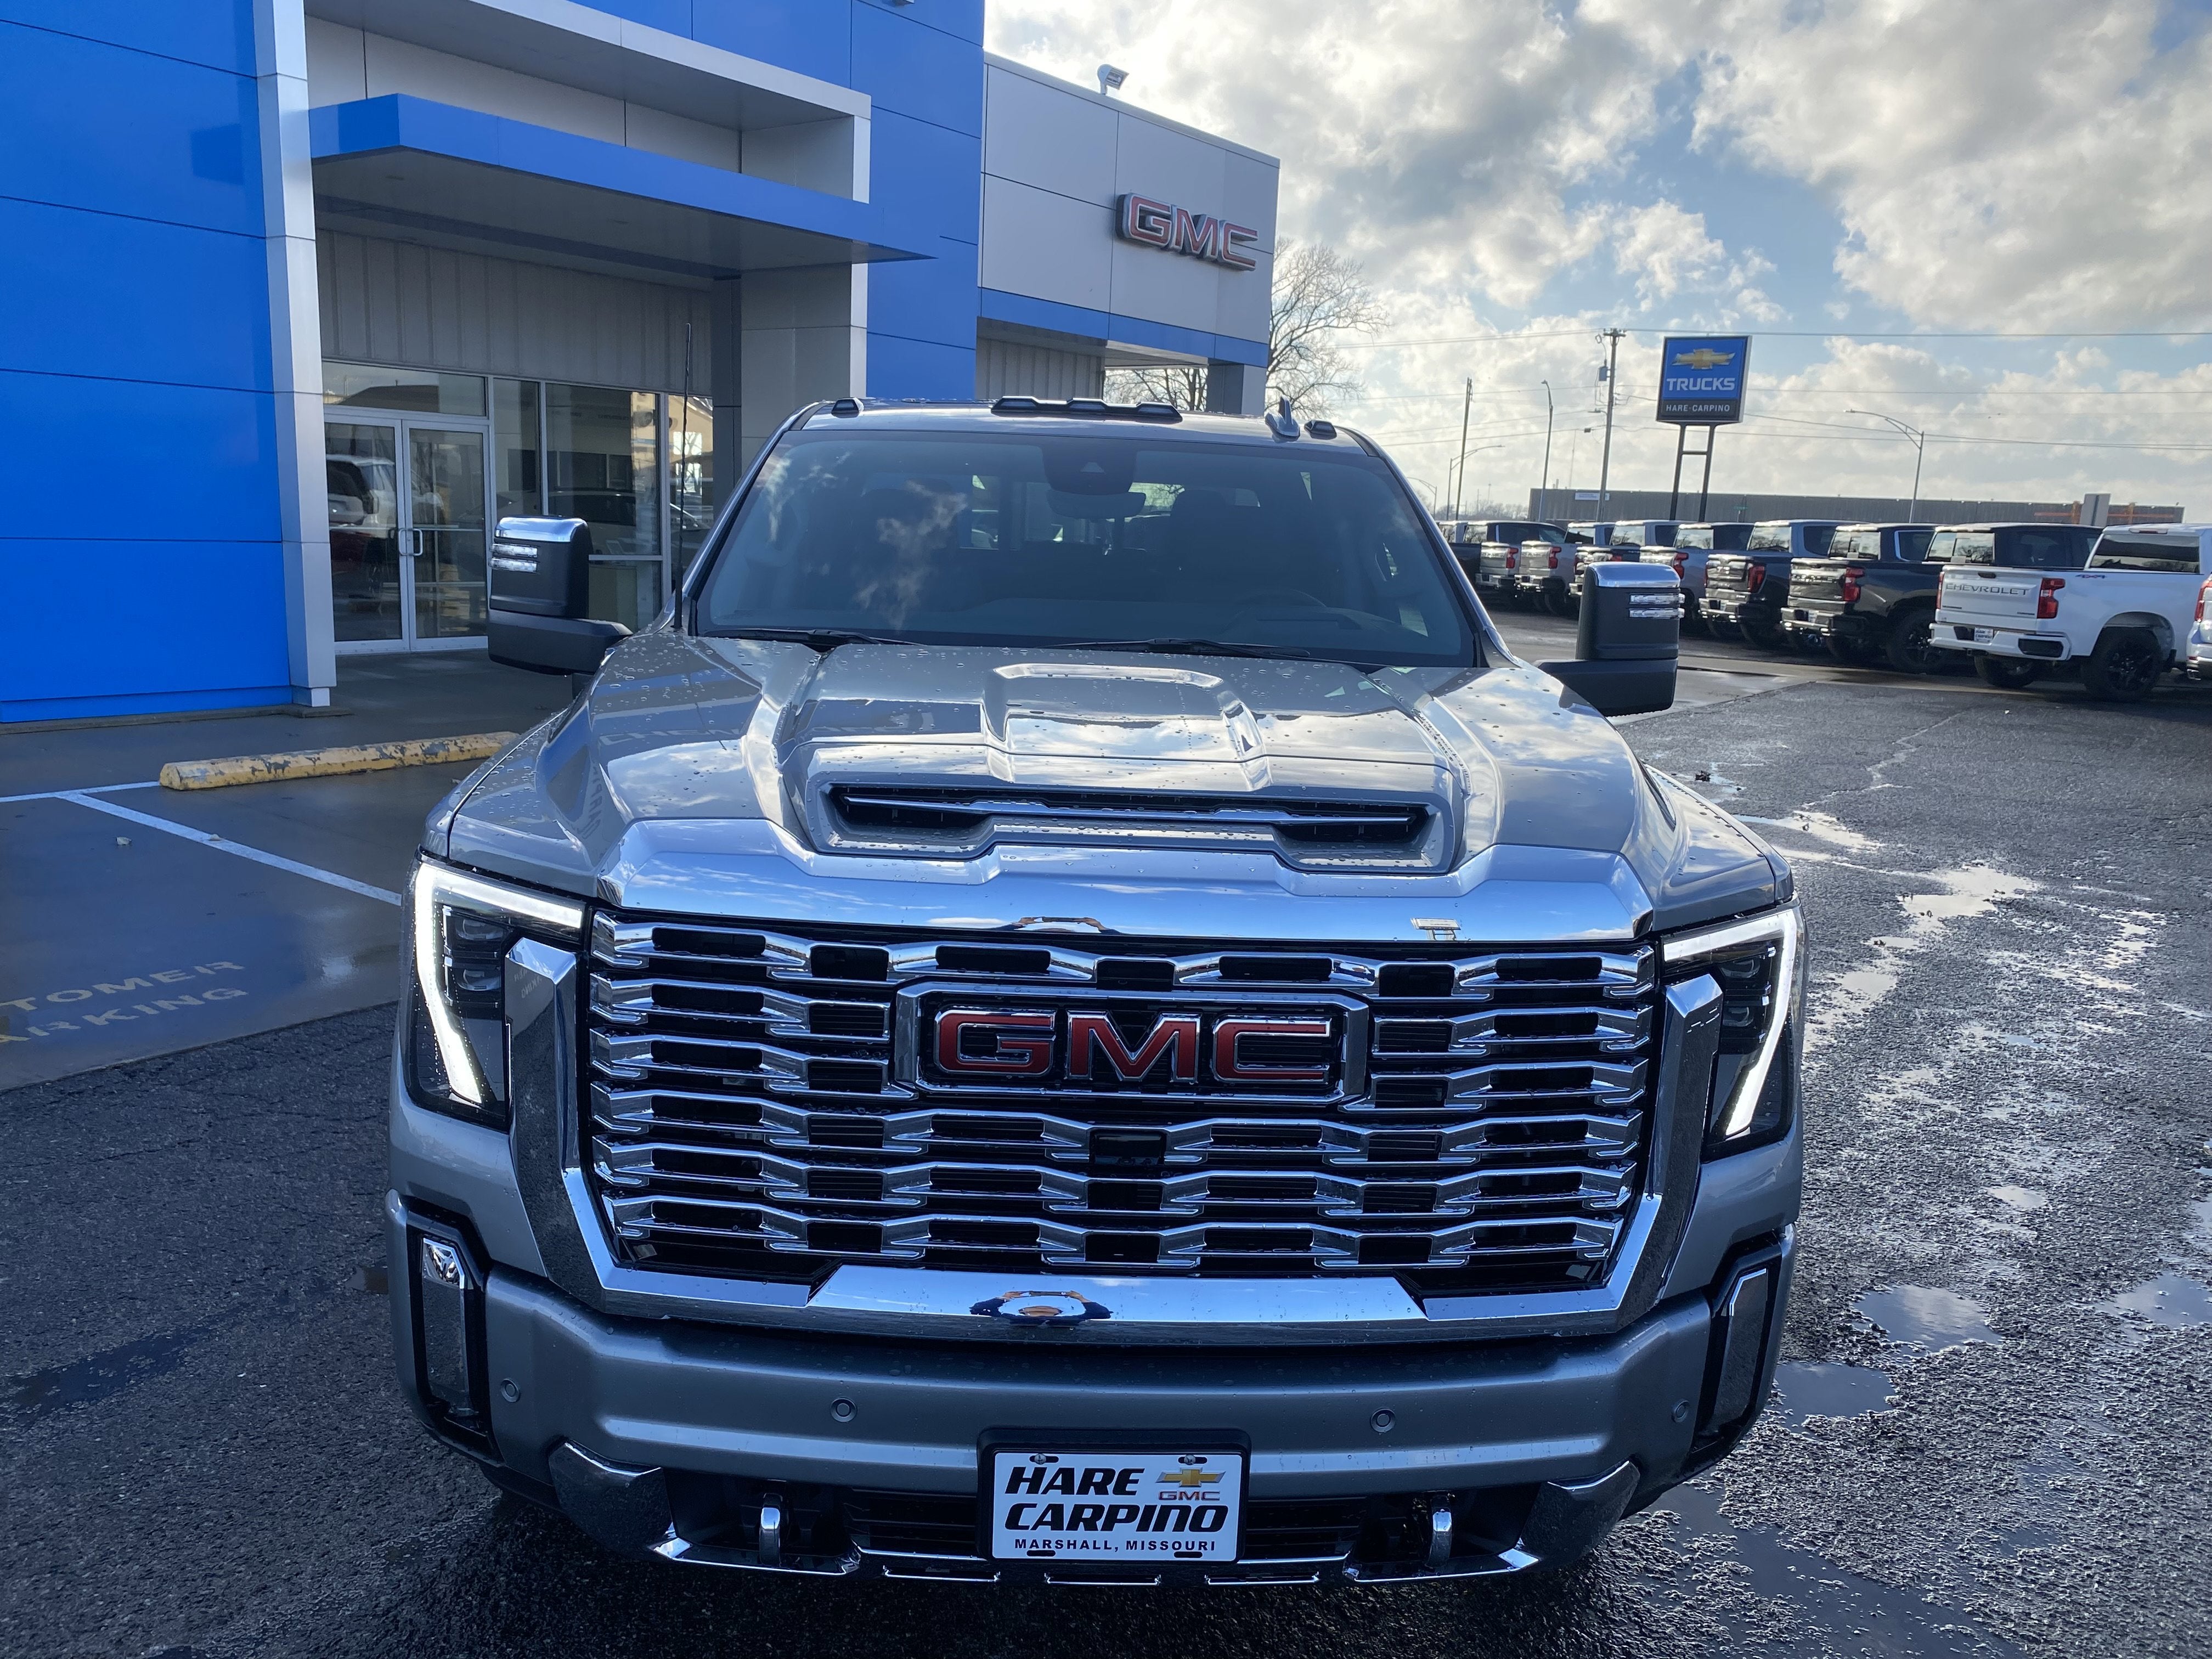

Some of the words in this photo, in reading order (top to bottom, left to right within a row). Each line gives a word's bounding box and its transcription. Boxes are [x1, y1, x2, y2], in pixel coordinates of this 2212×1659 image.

[1116, 193, 1259, 271] GMC
[1666, 377, 1736, 391] TRUCKS
[1945, 583, 2030, 595] CHEVROLET
[934, 1005, 1332, 1084] GMC
[1005, 1466, 1146, 1496] HARE
[1158, 1491, 1221, 1502] GMC
[1004, 1503, 1229, 1532] CARPINO
[1014, 1538, 1119, 1553] MARSHALL,
[1125, 1540, 1216, 1551] MISSOURI
